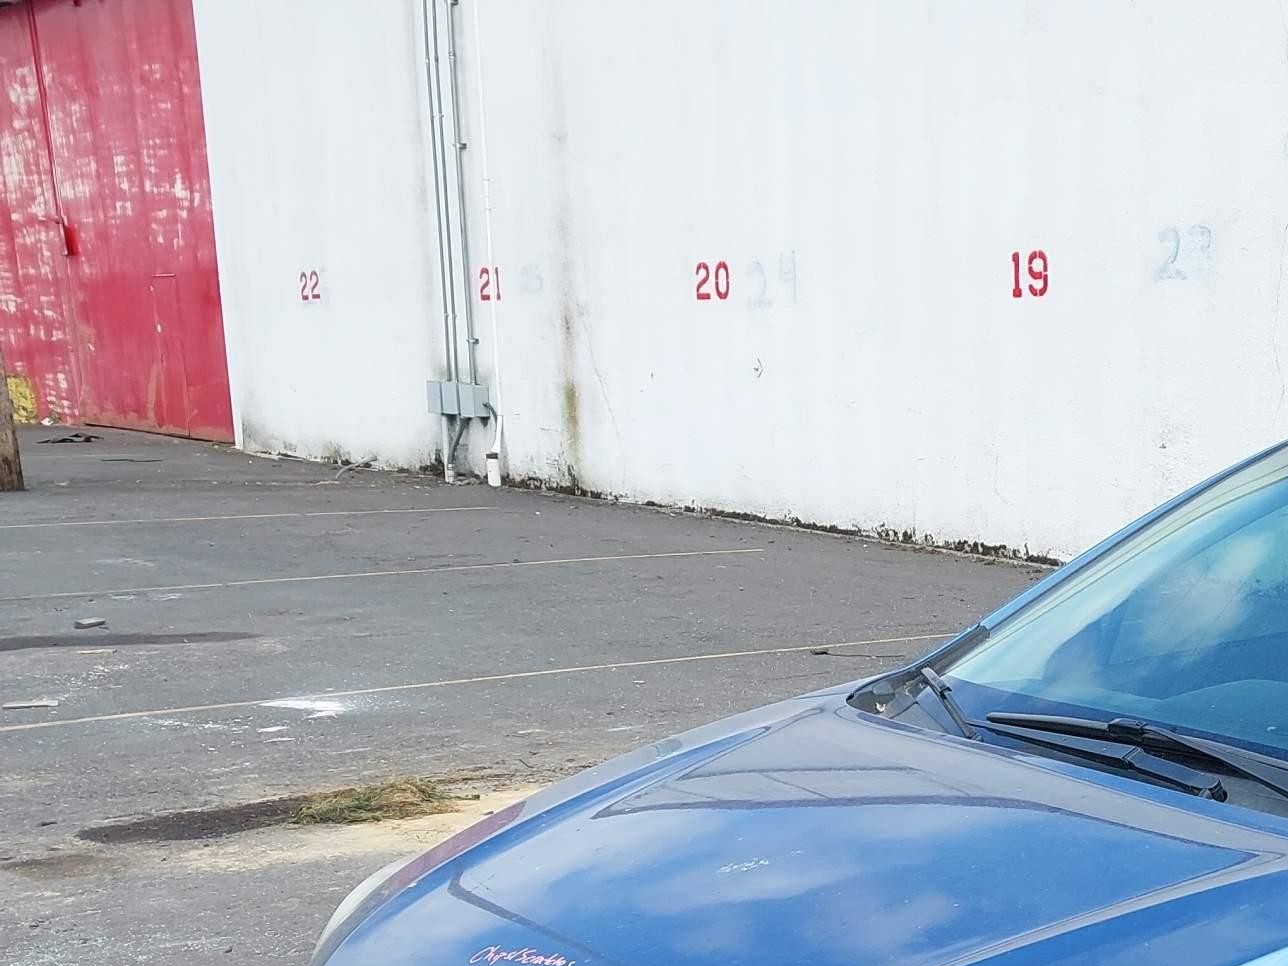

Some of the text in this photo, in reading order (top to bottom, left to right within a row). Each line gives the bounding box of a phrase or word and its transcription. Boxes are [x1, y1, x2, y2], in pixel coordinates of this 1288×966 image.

[299, 270, 321, 301] 22
[478, 266, 502, 301] 21
[695, 260, 730, 301] 20
[1011, 249, 1049, 298] 19
